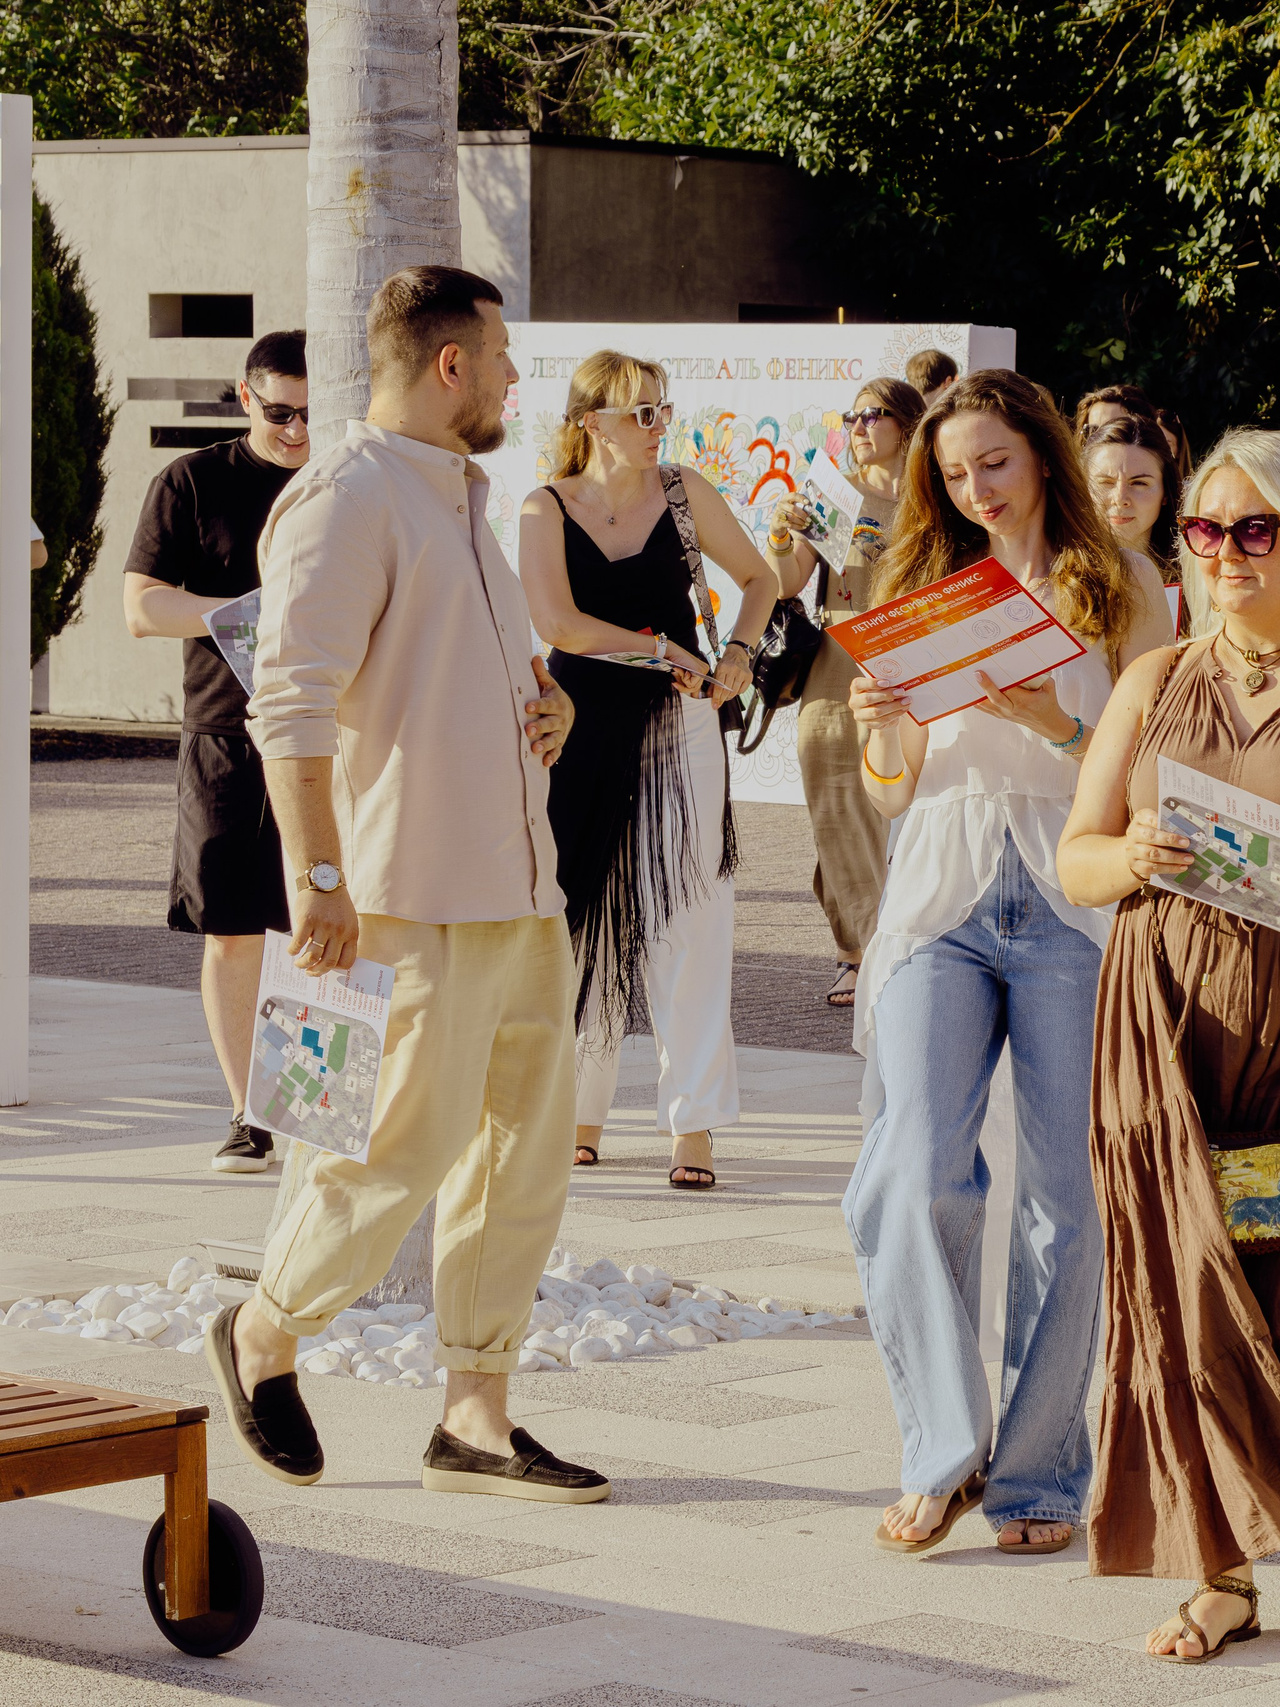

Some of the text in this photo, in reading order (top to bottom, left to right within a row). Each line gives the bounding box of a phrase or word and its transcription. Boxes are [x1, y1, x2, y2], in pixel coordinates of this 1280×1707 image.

[766, 357, 863, 381] ФЕНИКС
[851, 572, 984, 635] ЛЕТНИЙ ФЕСТИВАЛЬ ФЕНИКС
